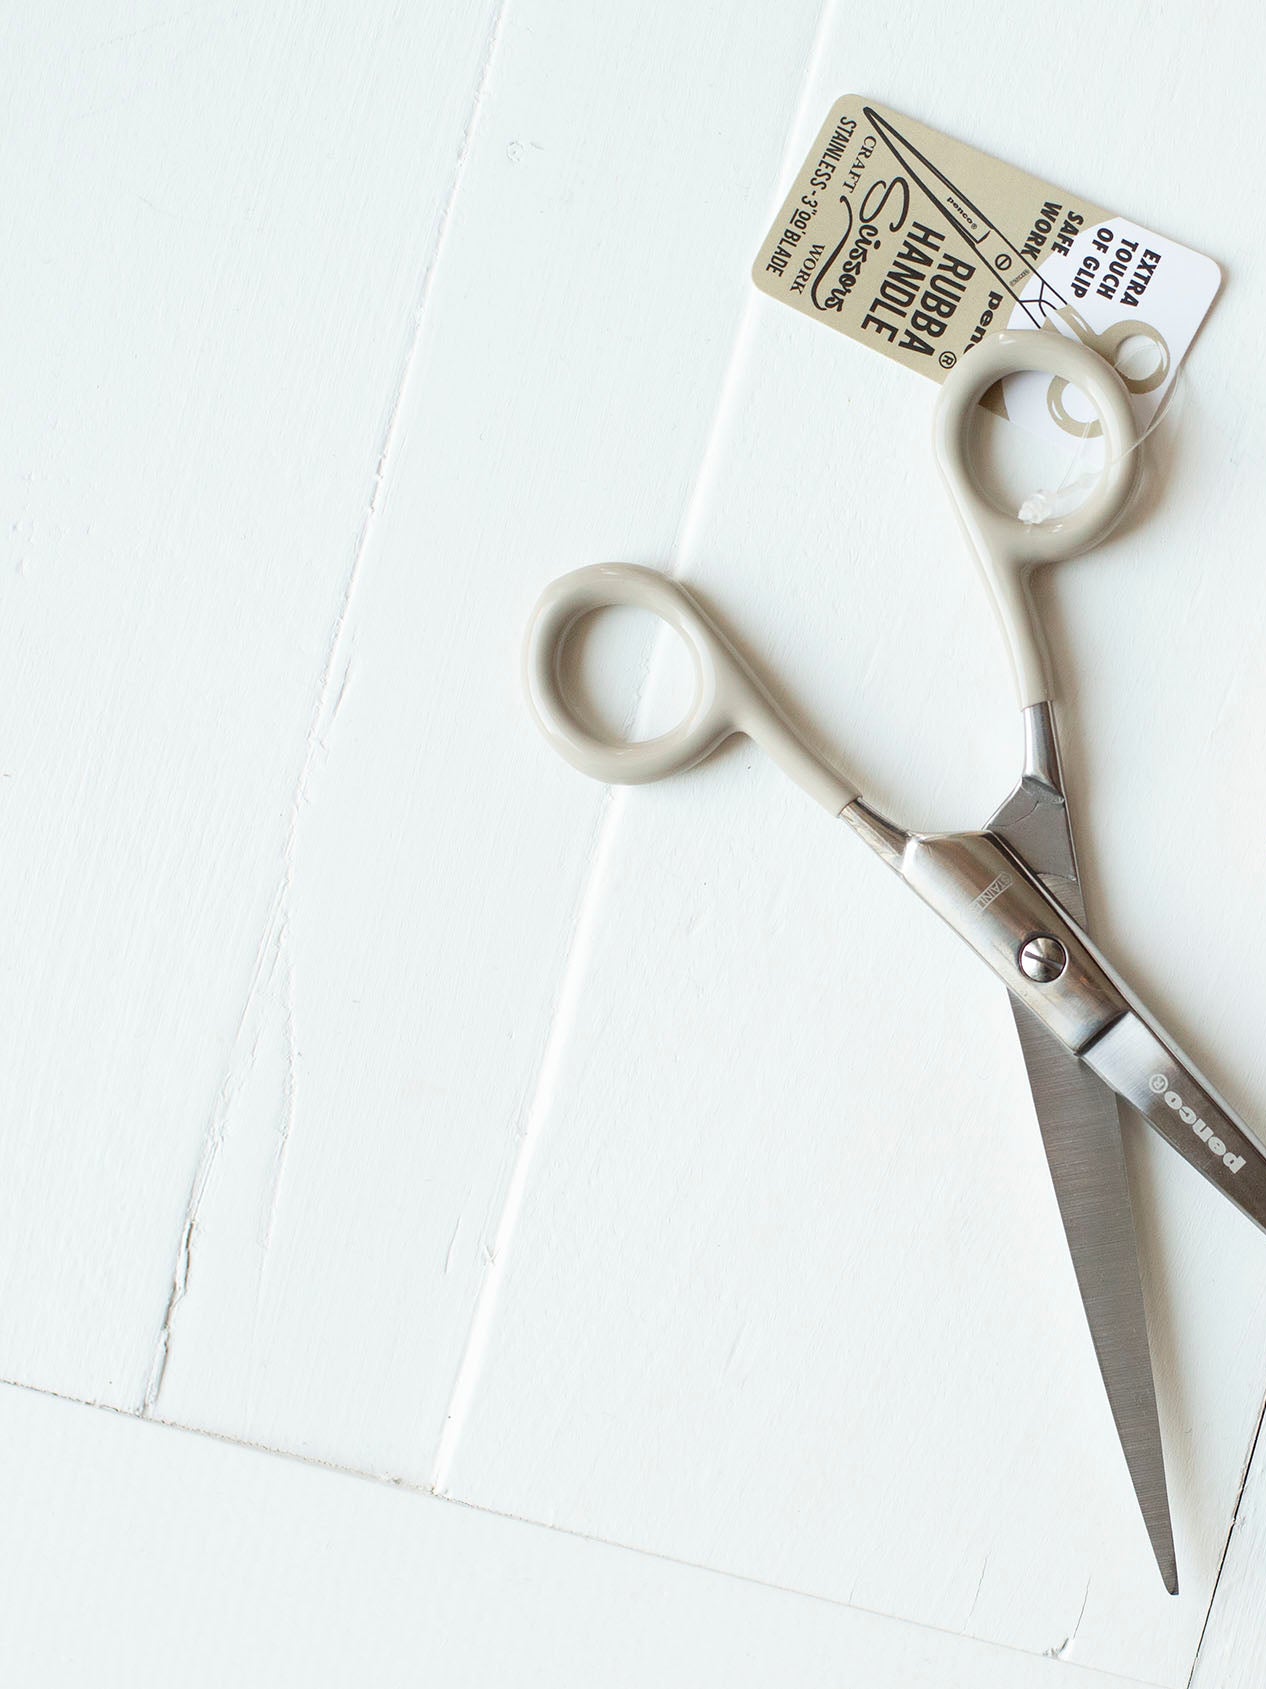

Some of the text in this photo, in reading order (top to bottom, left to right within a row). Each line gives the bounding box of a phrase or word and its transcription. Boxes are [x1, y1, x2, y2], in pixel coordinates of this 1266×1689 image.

[842, 135, 877, 194] CRAFT
[766, 228, 801, 277] BLADE
[824, 176, 909, 312] Scissors
[1020, 201, 1063, 261] WORK
[1051, 210, 1084, 257] SAFE
[789, 243, 826, 295] WORK
[861, 221, 946, 343] HANDLE
[1070, 227, 1114, 298] OF GLIP
[1096, 238, 1139, 300] TOUCH
[1120, 249, 1162, 307] EXTRA
